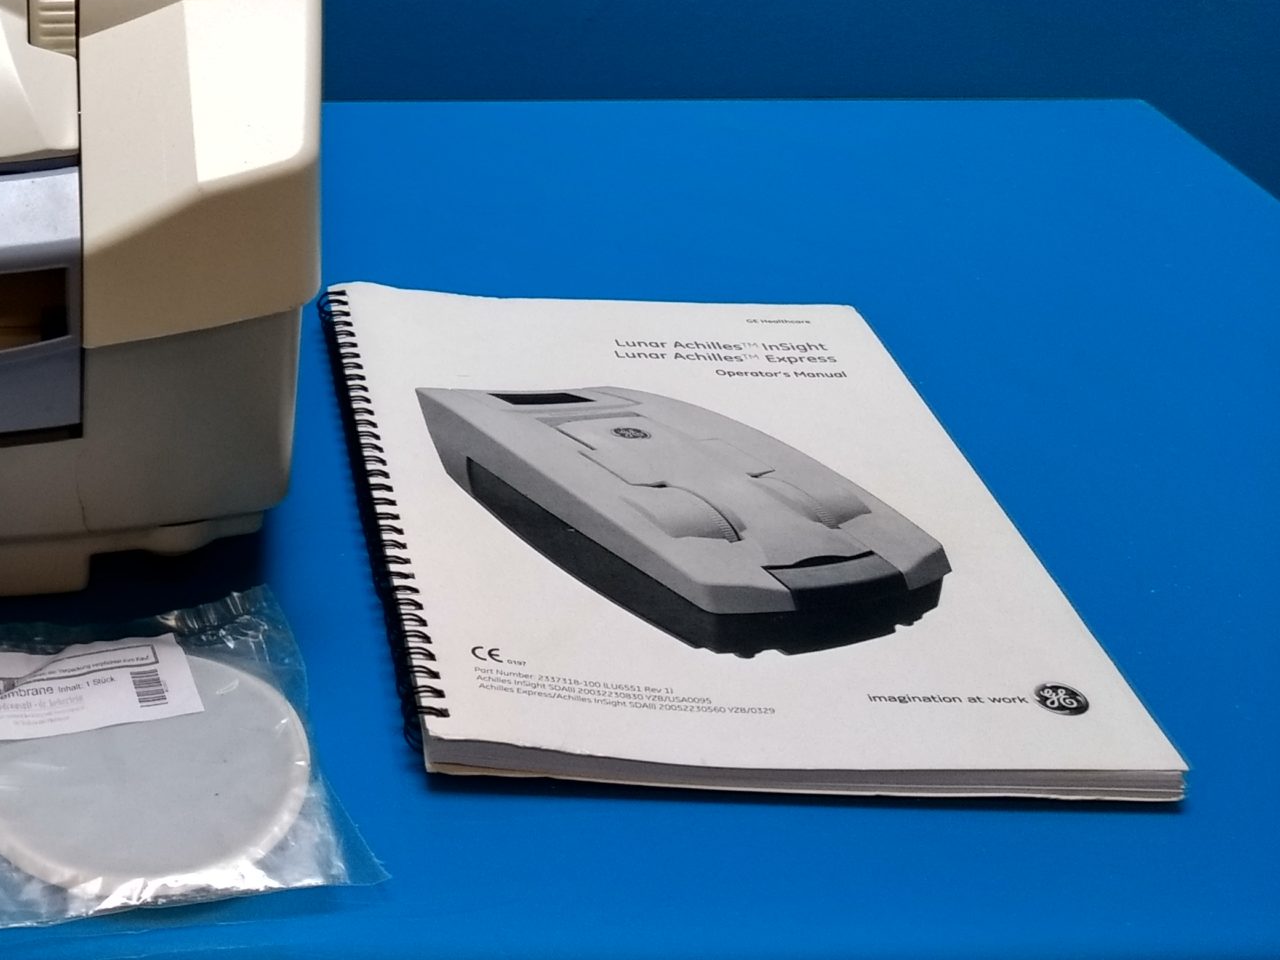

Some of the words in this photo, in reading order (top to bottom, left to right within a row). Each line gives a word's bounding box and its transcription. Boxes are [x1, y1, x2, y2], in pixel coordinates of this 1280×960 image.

[615, 339, 667, 349] Lunar
[762, 342, 828, 353] InSight
[614, 350, 667, 361] Lunar
[765, 354, 837, 366] Express
[715, 369, 791, 379] Operator's
[795, 371, 847, 379] Manual
[474, 666, 493, 674] Part
[476, 675, 511, 685] Achilles
[514, 679, 546, 689] InSight
[479, 683, 514, 693] Achilles
[594, 698, 626, 708] InSight
[867, 693, 962, 704] imagination
[967, 695, 984, 704] at
[988, 695, 1029, 704] work
